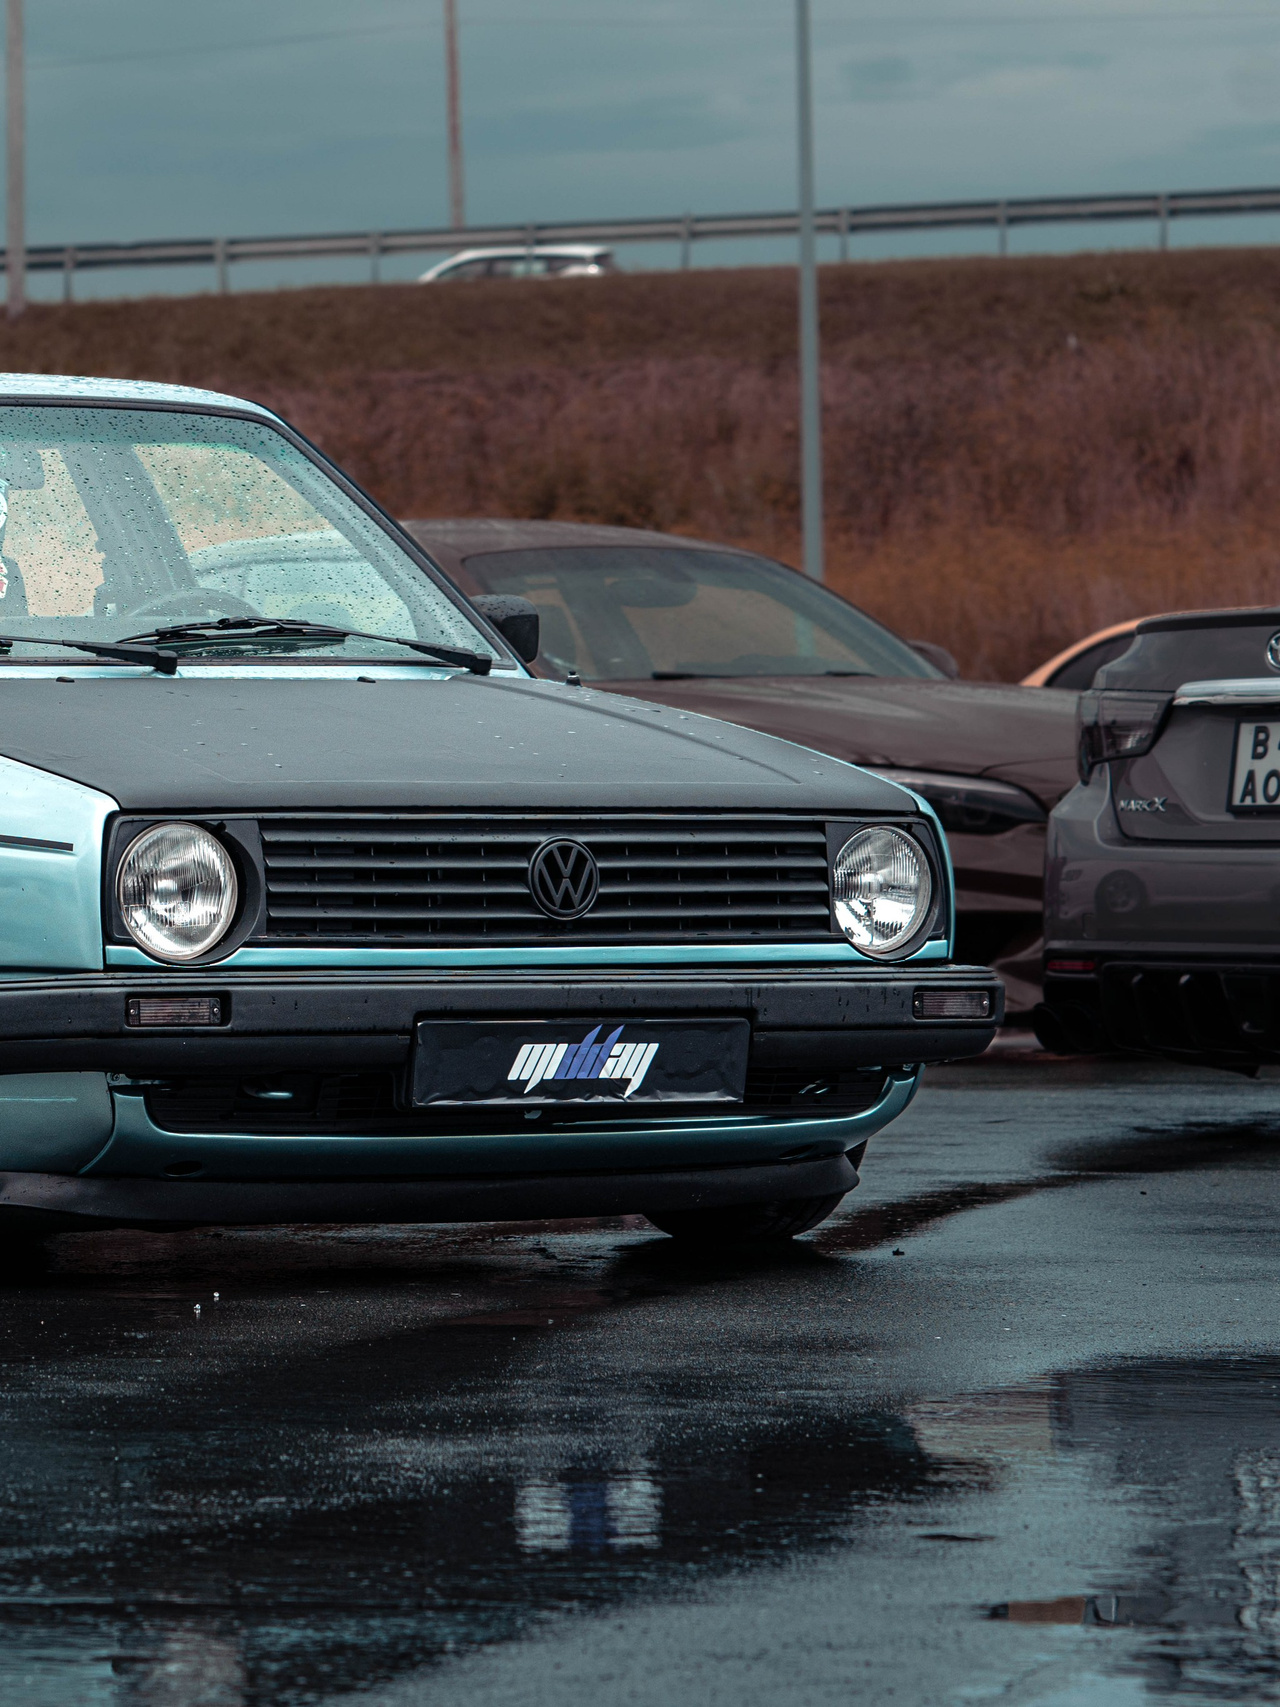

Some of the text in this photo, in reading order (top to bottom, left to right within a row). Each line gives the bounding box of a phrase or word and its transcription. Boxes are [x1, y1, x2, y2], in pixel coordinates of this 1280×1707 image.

[1251, 725, 1280, 760] B
[534, 841, 596, 914] VW
[507, 1024, 660, 1099] midday
